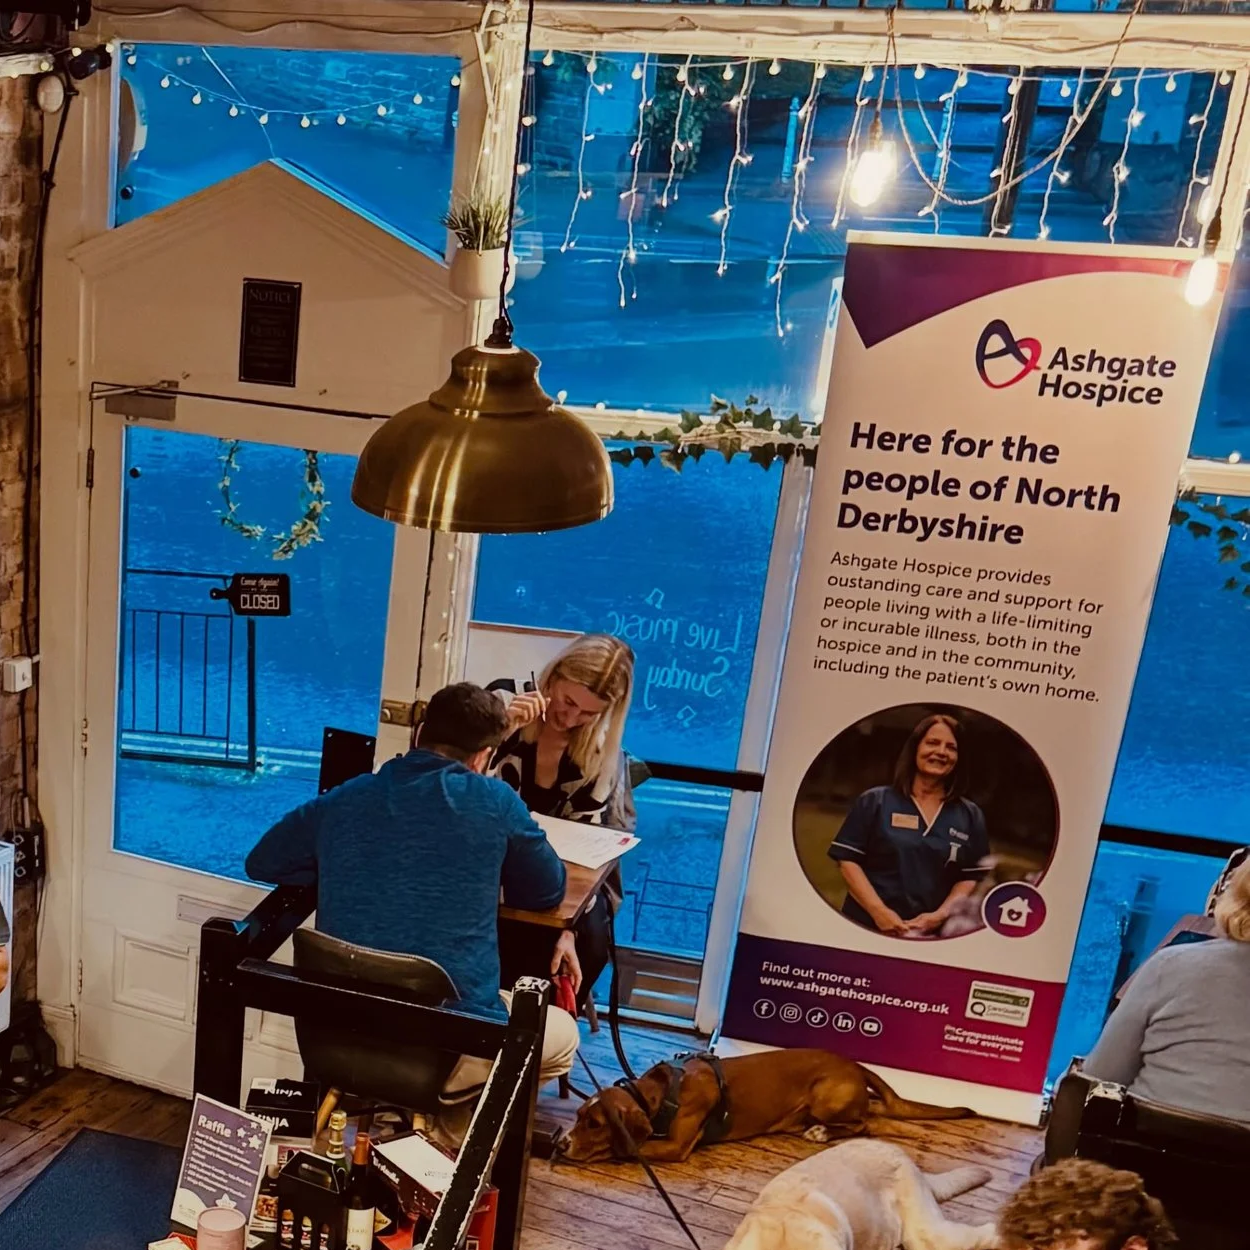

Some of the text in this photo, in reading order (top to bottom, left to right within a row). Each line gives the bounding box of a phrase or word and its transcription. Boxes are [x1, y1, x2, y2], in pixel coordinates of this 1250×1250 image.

[1048, 347, 1176, 380] Ashgate
[1038, 374, 1163, 407] Hospice
[850, 422, 1060, 464] Here for the
[842, 468, 1120, 512] people of North
[837, 503, 1024, 544] Derbyshire
[831, 551, 1051, 586] Ashgate Hospice provides
[241, 594, 279, 609] CLOSED
[827, 575, 1104, 614] oustanding care and support for
[820, 616, 1081, 656] or incurable illness, both in the
[823, 596, 1092, 639] people living with a life-limiting
[817, 635, 1076, 680] hospice and in the community,
[813, 655, 1099, 702] including the patient's own home.
[762, 961, 871, 988] Find out more at:
[760, 975, 949, 1015] www.ashgatehospice.org.uk
[981, 1040, 1023, 1053] everyone
[198, 1115, 232, 1137] Raffle
